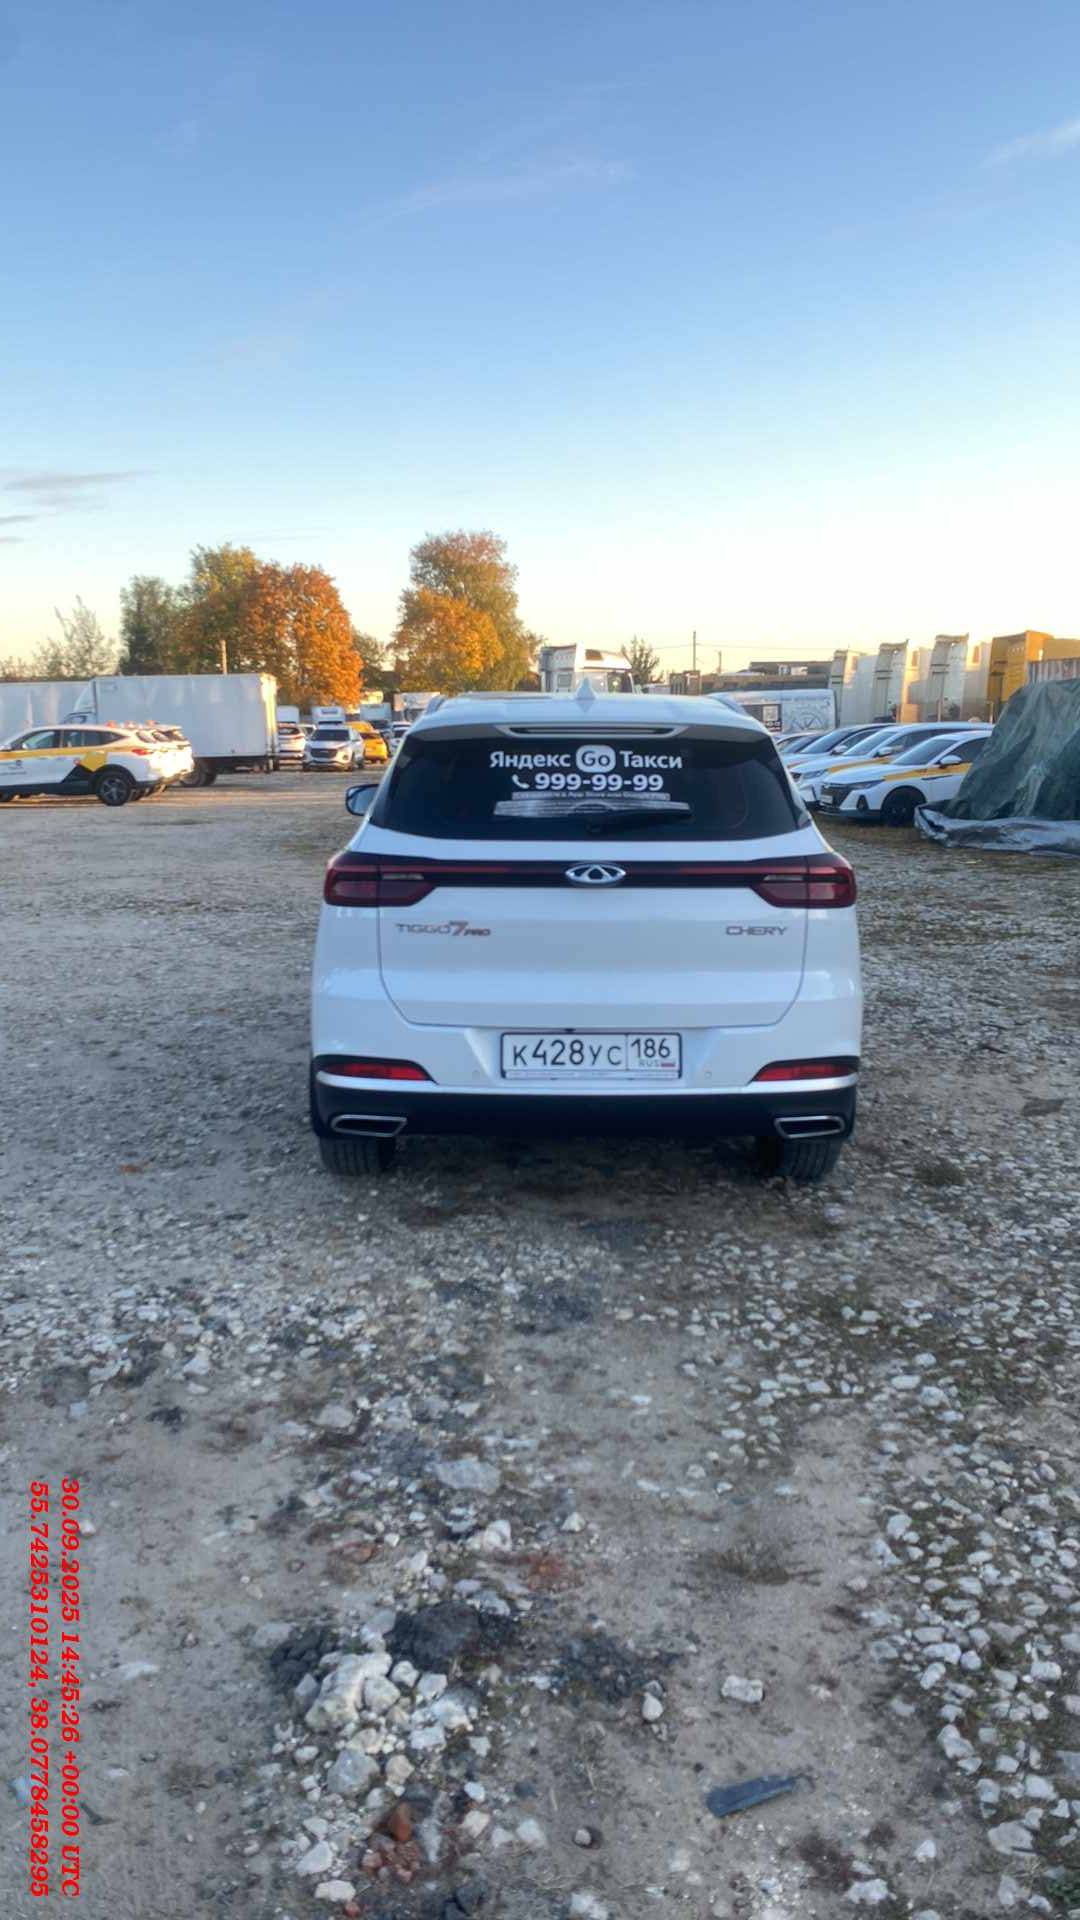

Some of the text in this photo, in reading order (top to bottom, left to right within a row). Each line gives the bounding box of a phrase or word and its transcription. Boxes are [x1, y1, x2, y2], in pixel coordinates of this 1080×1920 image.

[490, 749, 683, 769] Яндекс Go Такси
[535, 773, 663, 791] 999-99-99
[726, 926, 786, 936] CHERY
[631, 1038, 671, 1058] 186
